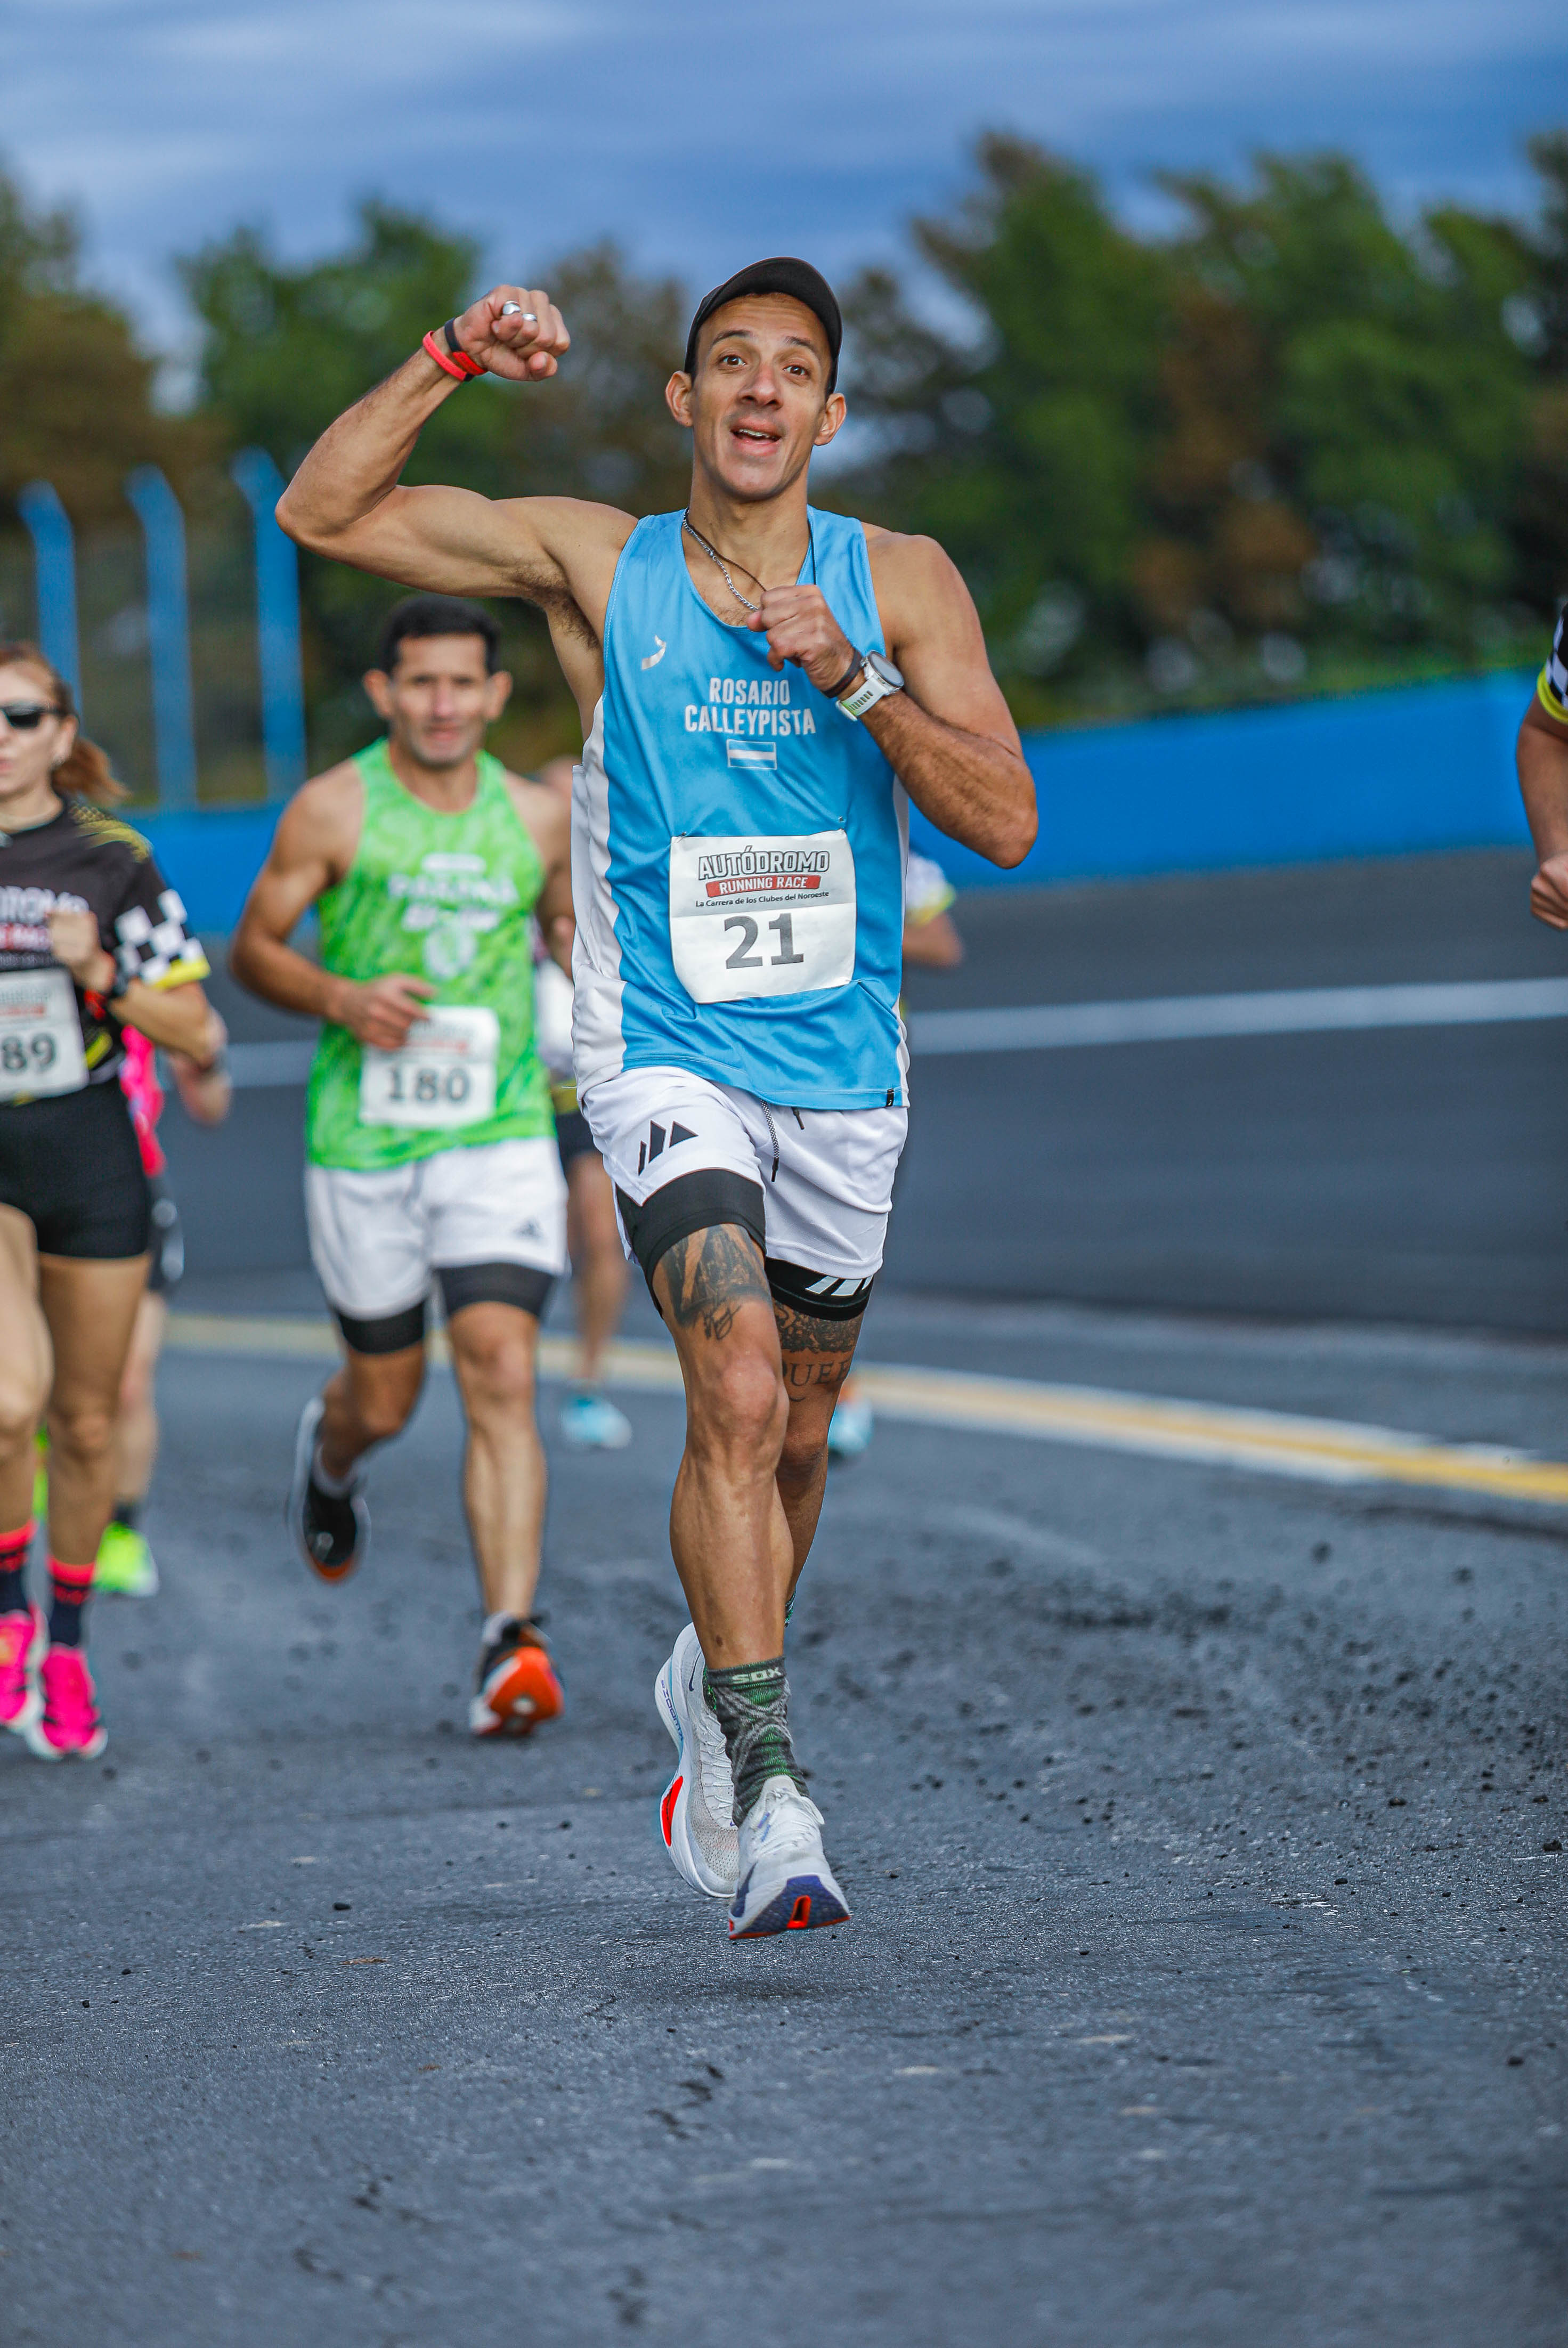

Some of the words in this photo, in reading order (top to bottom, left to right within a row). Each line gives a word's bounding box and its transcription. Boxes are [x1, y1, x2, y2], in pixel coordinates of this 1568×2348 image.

[710, 678, 790, 704] ROSARIO
[685, 705, 816, 735] CALLEYPISTA
[698, 846, 830, 880] AUTÓDROMO
[719, 877, 773, 895] RUNNING
[776, 875, 808, 888] RACE
[798, 891, 829, 899] Noroeste
[724, 913, 804, 969] 21
[388, 1067, 471, 1103] 180
